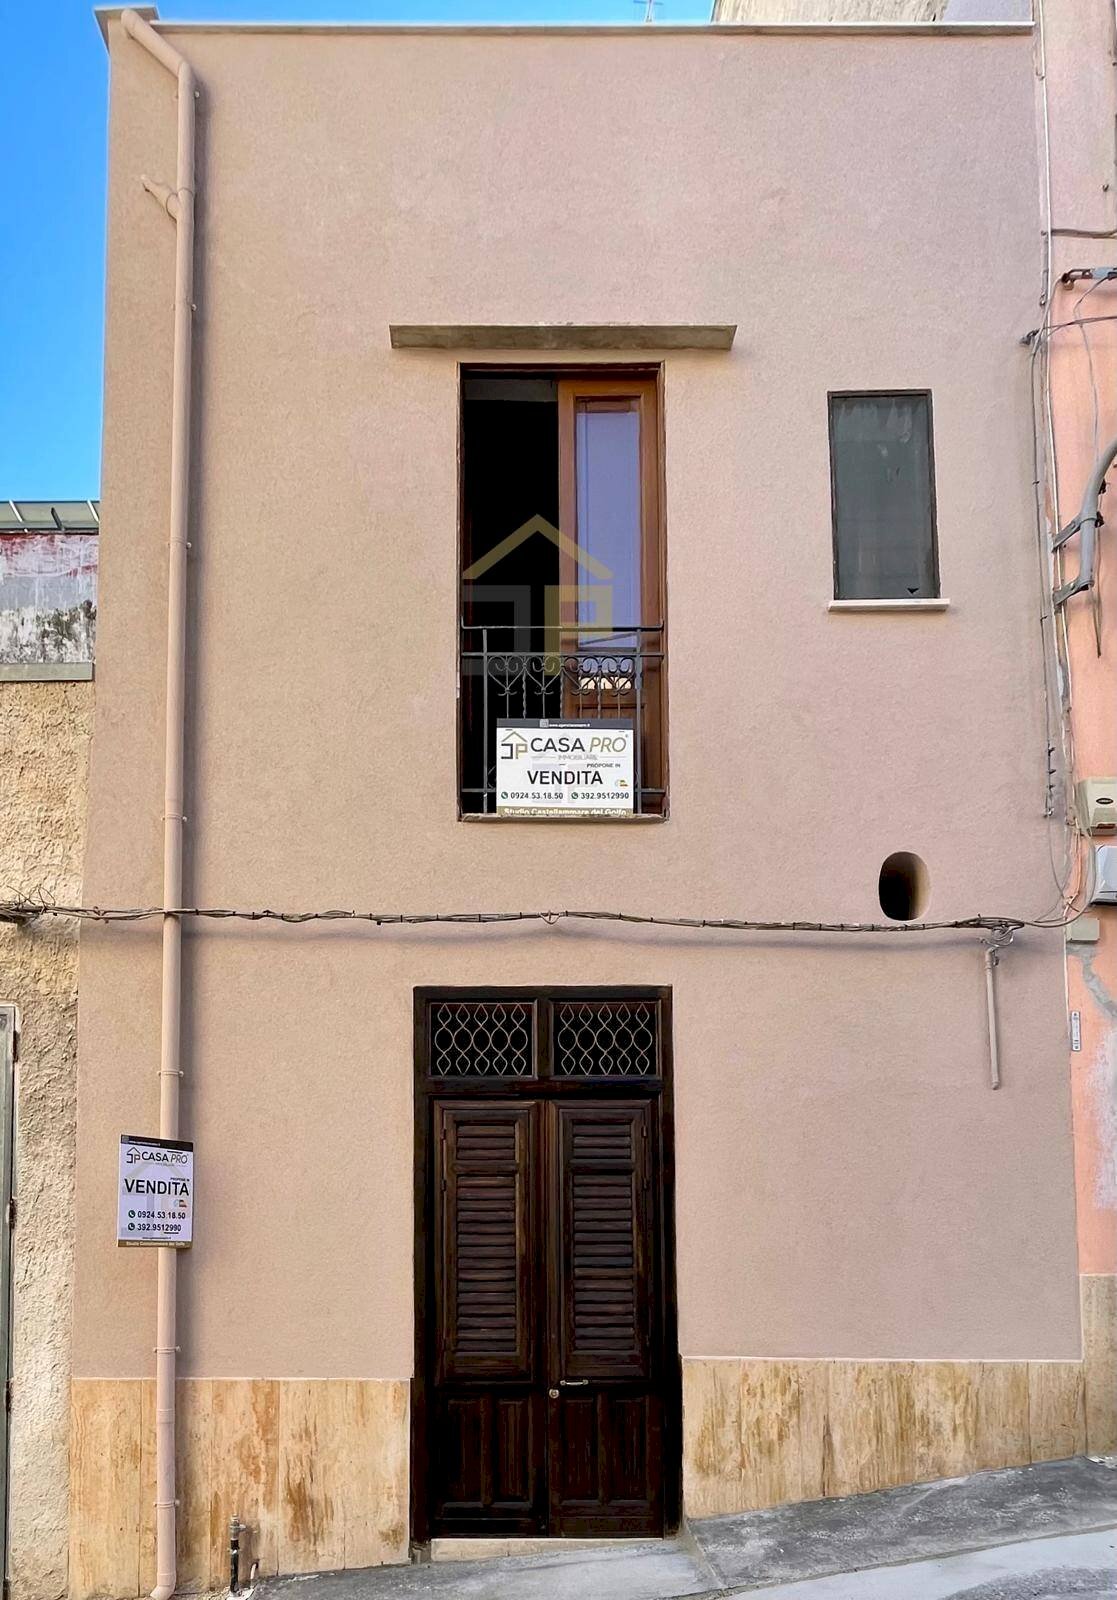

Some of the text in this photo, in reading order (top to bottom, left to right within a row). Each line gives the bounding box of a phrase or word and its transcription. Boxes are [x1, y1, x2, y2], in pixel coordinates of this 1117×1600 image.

[530, 737, 627, 752] CASA PRO
[527, 770, 603, 785] VENDITA
[510, 791, 564, 800] 0924.53.18.50
[580, 791, 629, 800] 392.9512990
[141, 1151, 169, 1162] CASA
[170, 1153, 188, 1164] PRO
[124, 1178, 190, 1196] VENDITA
[137, 1210, 186, 1219] 0924.53.18.50
[137, 1223, 182, 1232] 392.9512990
